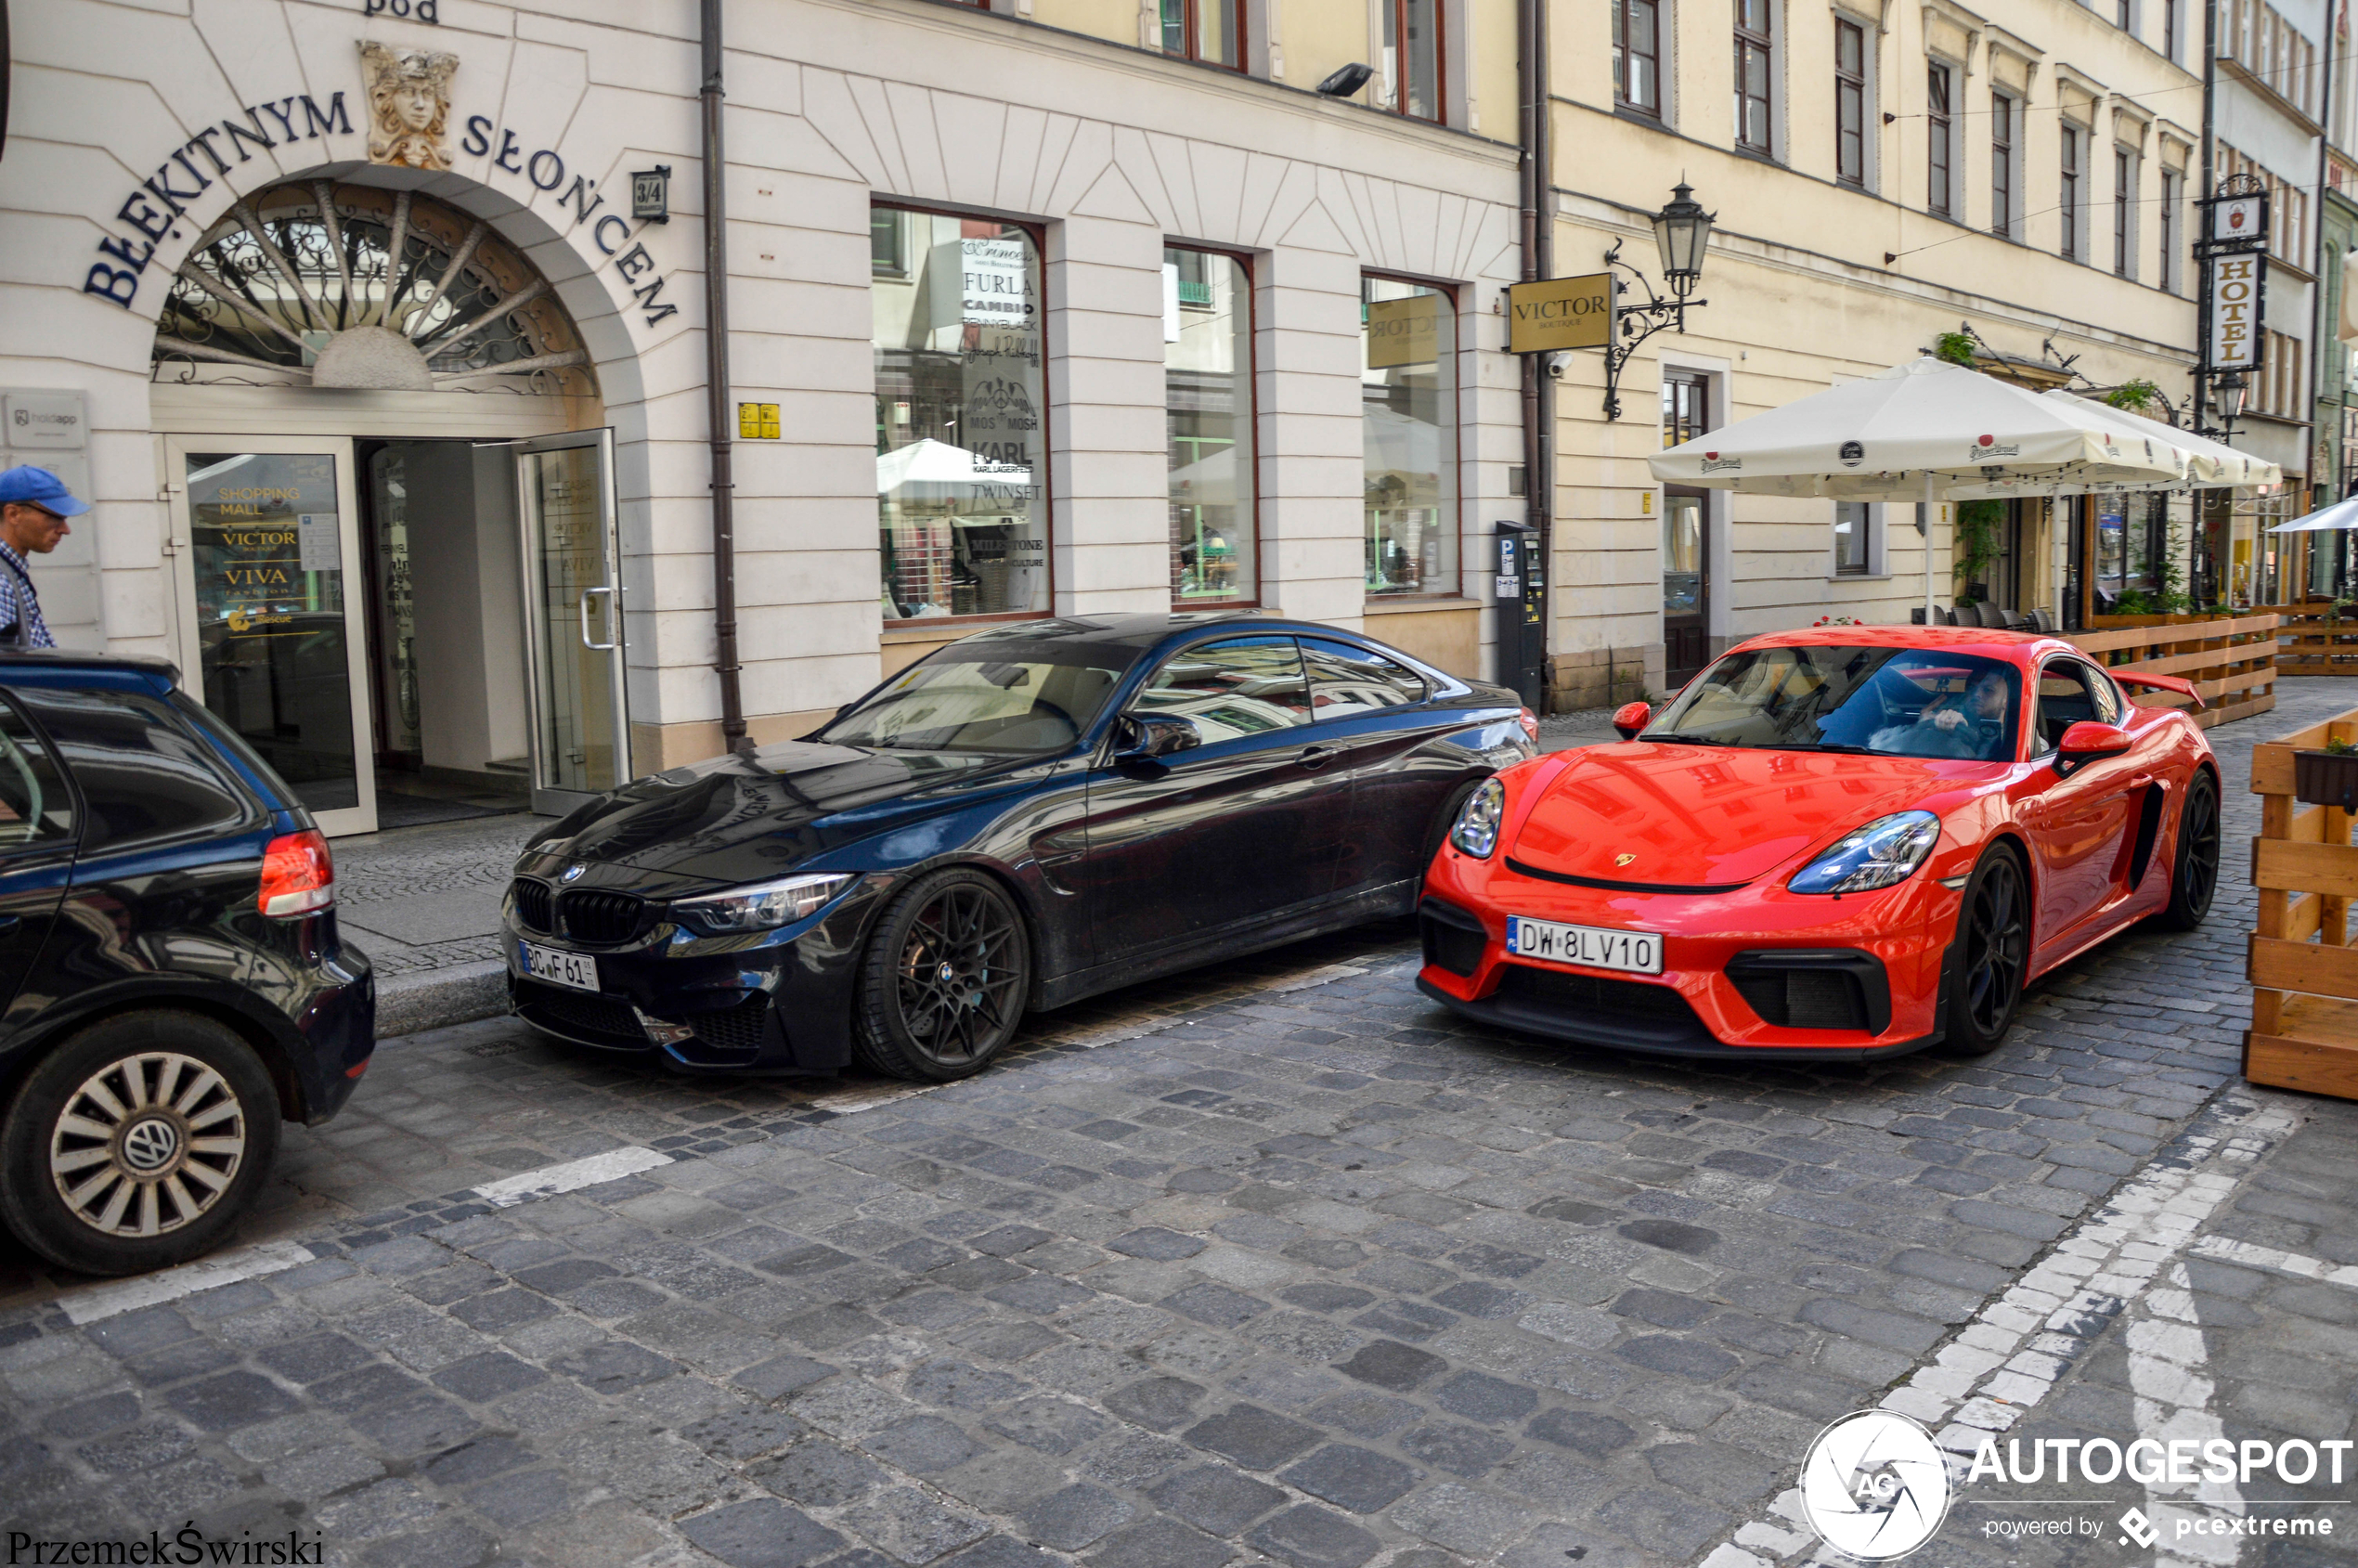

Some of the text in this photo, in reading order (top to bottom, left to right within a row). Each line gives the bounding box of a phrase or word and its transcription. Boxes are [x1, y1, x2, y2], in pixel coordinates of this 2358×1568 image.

[637, 181, 661, 203] 3/4
[84, 91, 679, 329] BŁĘKITNYM SŁOŃCEM
[963, 272, 1034, 296] FURLA
[962, 299, 1034, 315] CAMBIO
[1515, 295, 1607, 320] VICTOR
[2218, 260, 2253, 362] HOTEL
[962, 317, 1037, 331] PENNYBLACK
[1539, 317, 1582, 330] BOUTIQUE
[970, 417, 1038, 431] MOS MOSH
[972, 441, 1032, 464] KARL
[218, 487, 300, 500] SHOPPING
[970, 484, 1042, 500] TWINSET
[220, 503, 264, 516] MALL
[222, 531, 297, 546] VICTOR
[1501, 539, 1514, 554] P
[225, 569, 288, 585] VIVA
[226, 588, 289, 596] fashion
[1522, 923, 1651, 967] DW 8LV10
